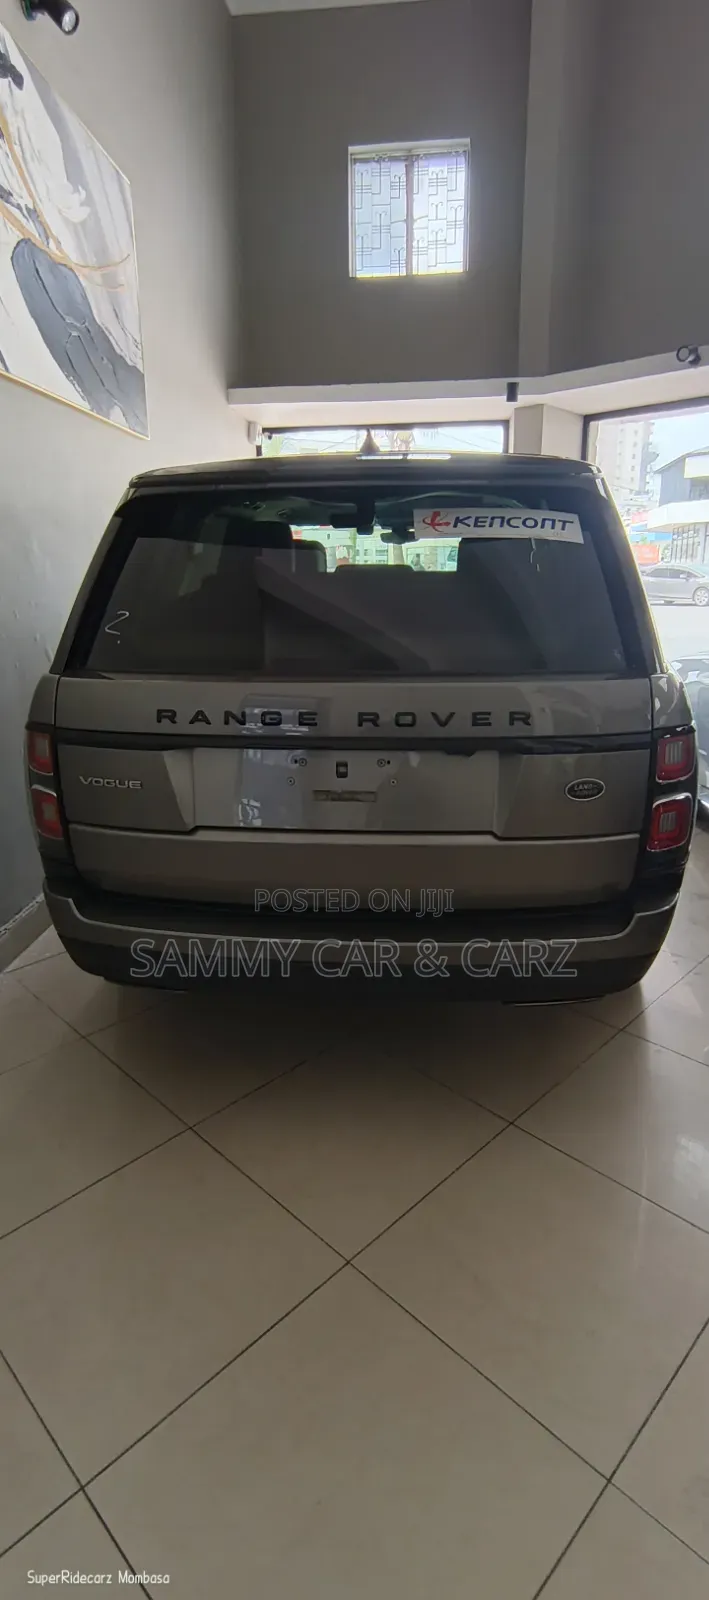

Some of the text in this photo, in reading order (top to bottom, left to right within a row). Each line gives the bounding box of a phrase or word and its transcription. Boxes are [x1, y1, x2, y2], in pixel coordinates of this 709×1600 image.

[156, 708, 533, 727] RANGE ROVER
[79, 775, 142, 789] VOGUE
